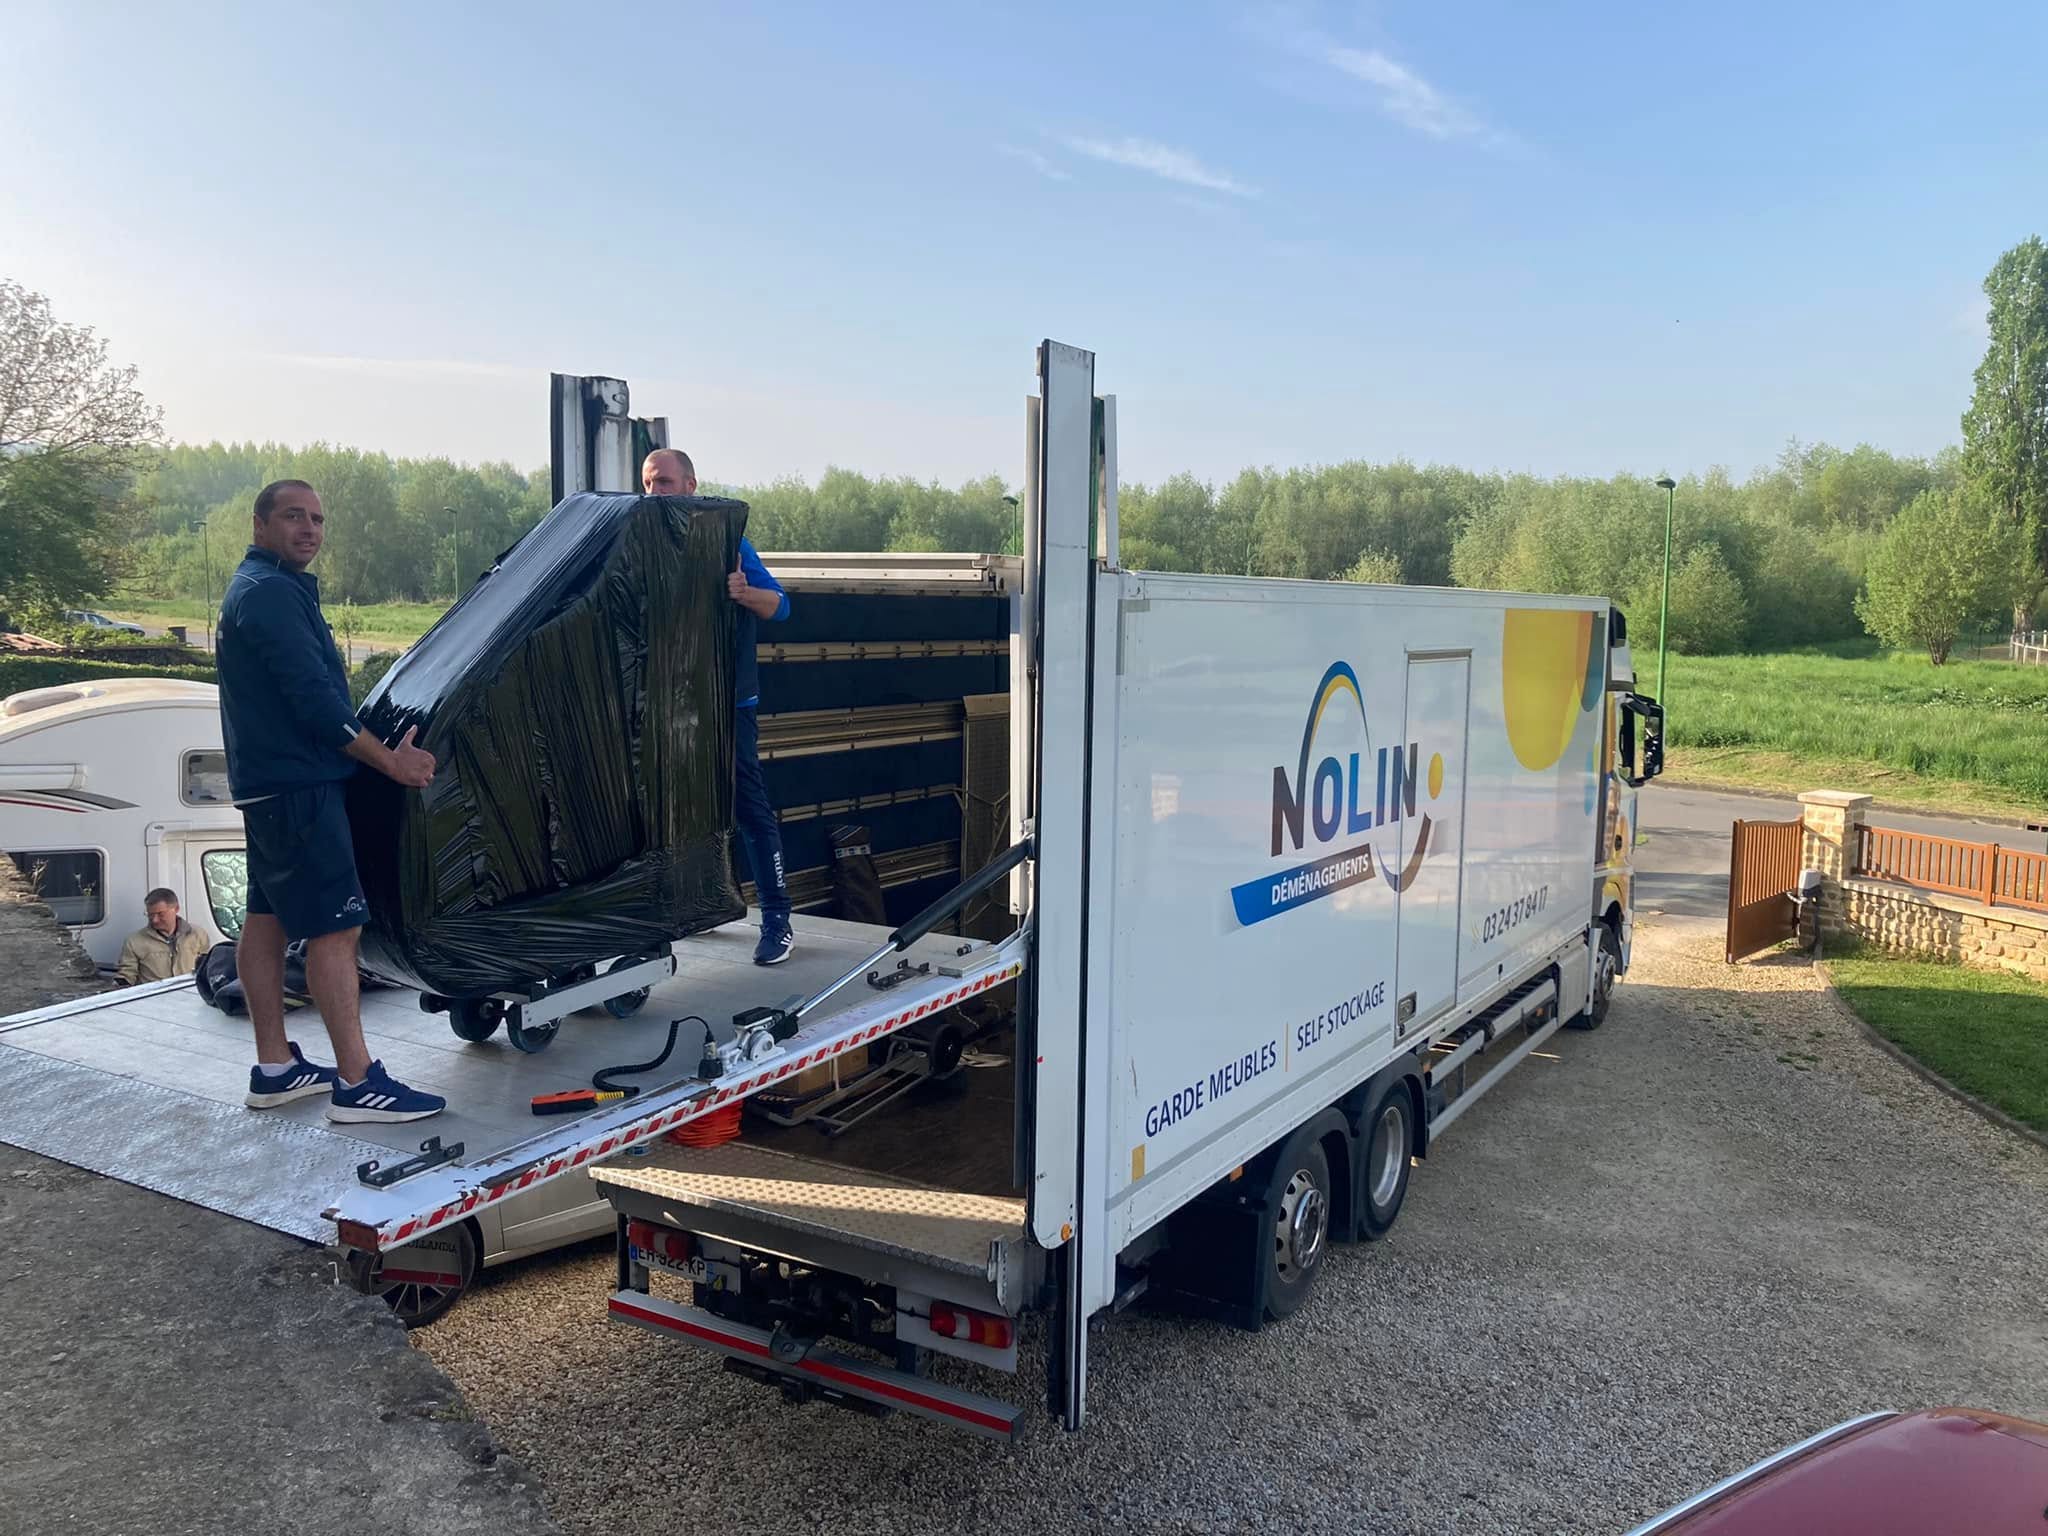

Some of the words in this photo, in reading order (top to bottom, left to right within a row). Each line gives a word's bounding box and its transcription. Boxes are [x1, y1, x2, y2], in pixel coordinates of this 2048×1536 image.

[1271, 742, 1418, 857] NOLIN
[1271, 853, 1369, 905] DÉMÉNAGEMENTS
[1145, 1080, 1204, 1138] GARDE
[1209, 1040, 1276, 1102] MEUBLES
[1297, 1014, 1324, 1051] SELF
[1327, 981, 1385, 1034] STOCKAGE
[402, 1239, 457, 1254] OLLANDIA
